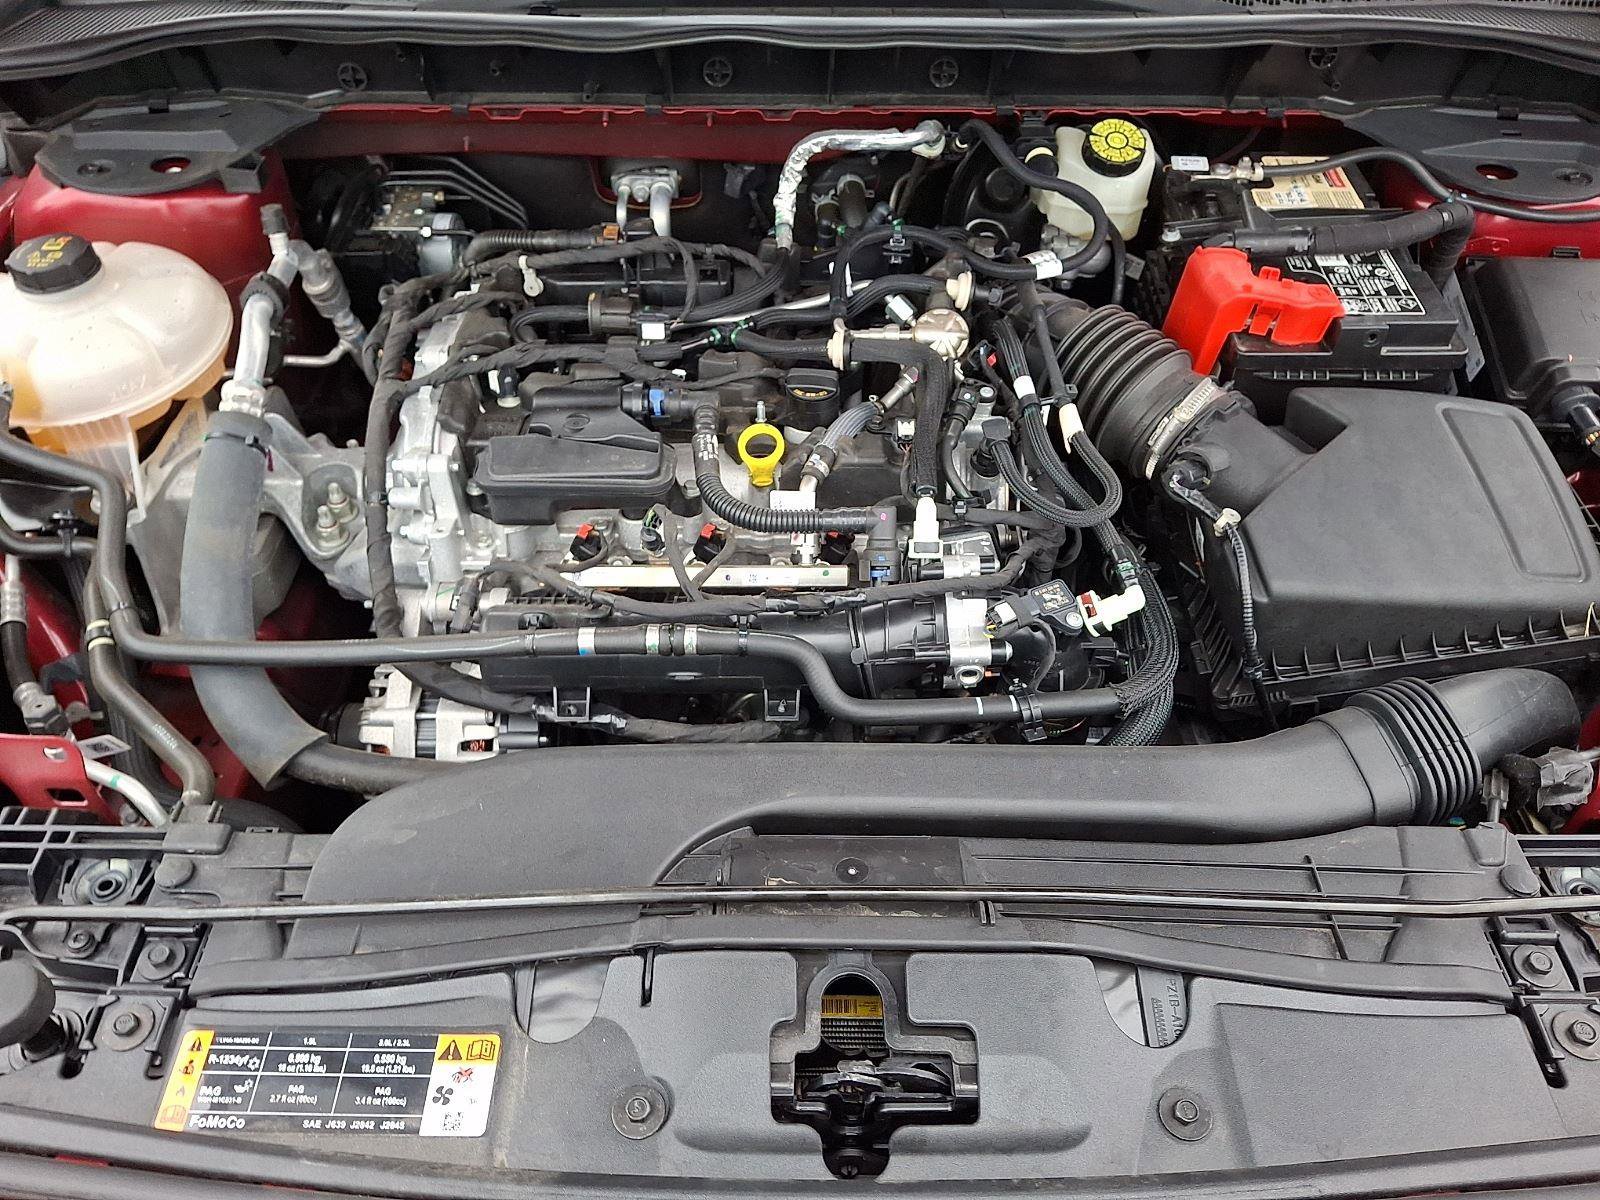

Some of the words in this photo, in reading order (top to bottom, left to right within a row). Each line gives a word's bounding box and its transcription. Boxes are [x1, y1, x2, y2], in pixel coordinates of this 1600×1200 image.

[207, 1053, 250, 1067] R-1234yf
[310, 1053, 322, 1066] kg
[397, 1053, 408, 1066] kg
[199, 1085, 221, 1097] PAG
[287, 1084, 305, 1094] PAG
[374, 1086, 392, 1096] PAG
[188, 1114, 246, 1129] FoMoCo
[302, 1119, 322, 1129] SAE
[324, 1119, 347, 1129] J639
